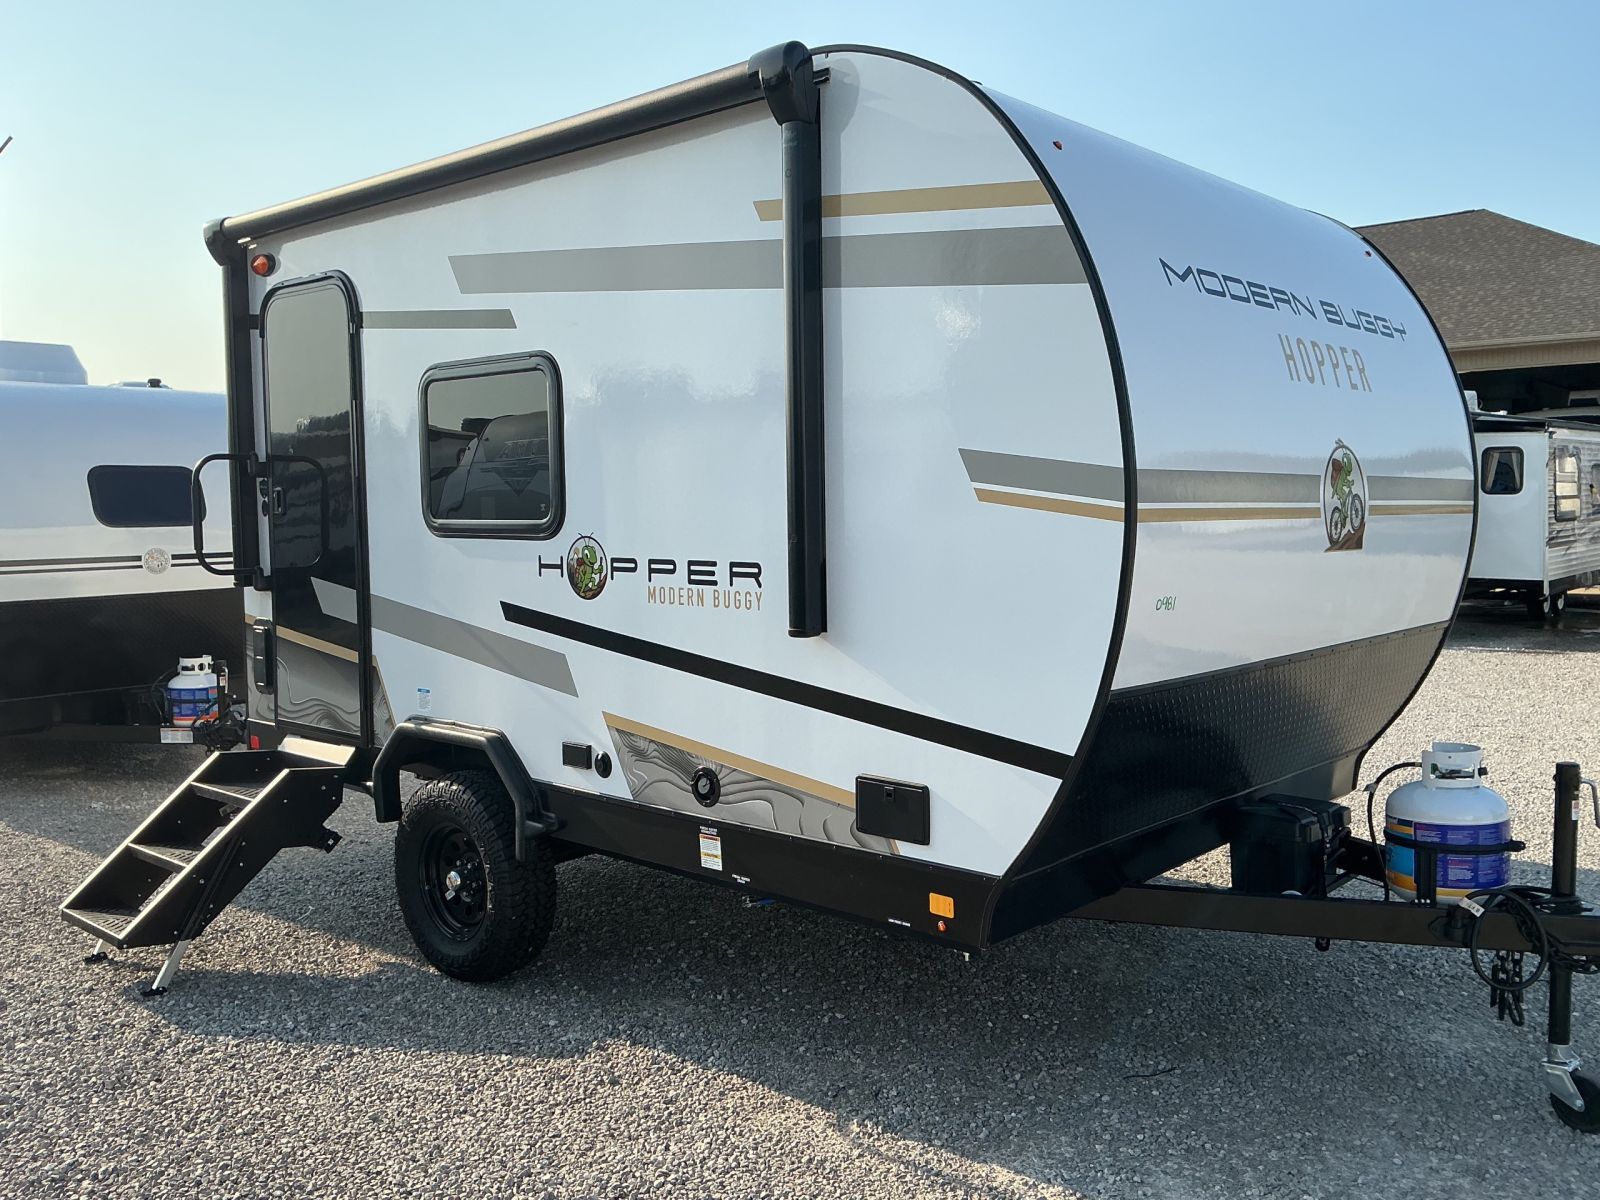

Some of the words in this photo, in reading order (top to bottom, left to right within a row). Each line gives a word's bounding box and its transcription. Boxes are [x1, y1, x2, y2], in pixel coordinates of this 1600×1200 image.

[1158, 257, 1318, 320] MODERN
[1318, 299, 1407, 342] BUGGY
[1277, 332, 1372, 393] HOPPER
[647, 585, 705, 608] MODERN
[713, 588, 763, 611] BUGGY
